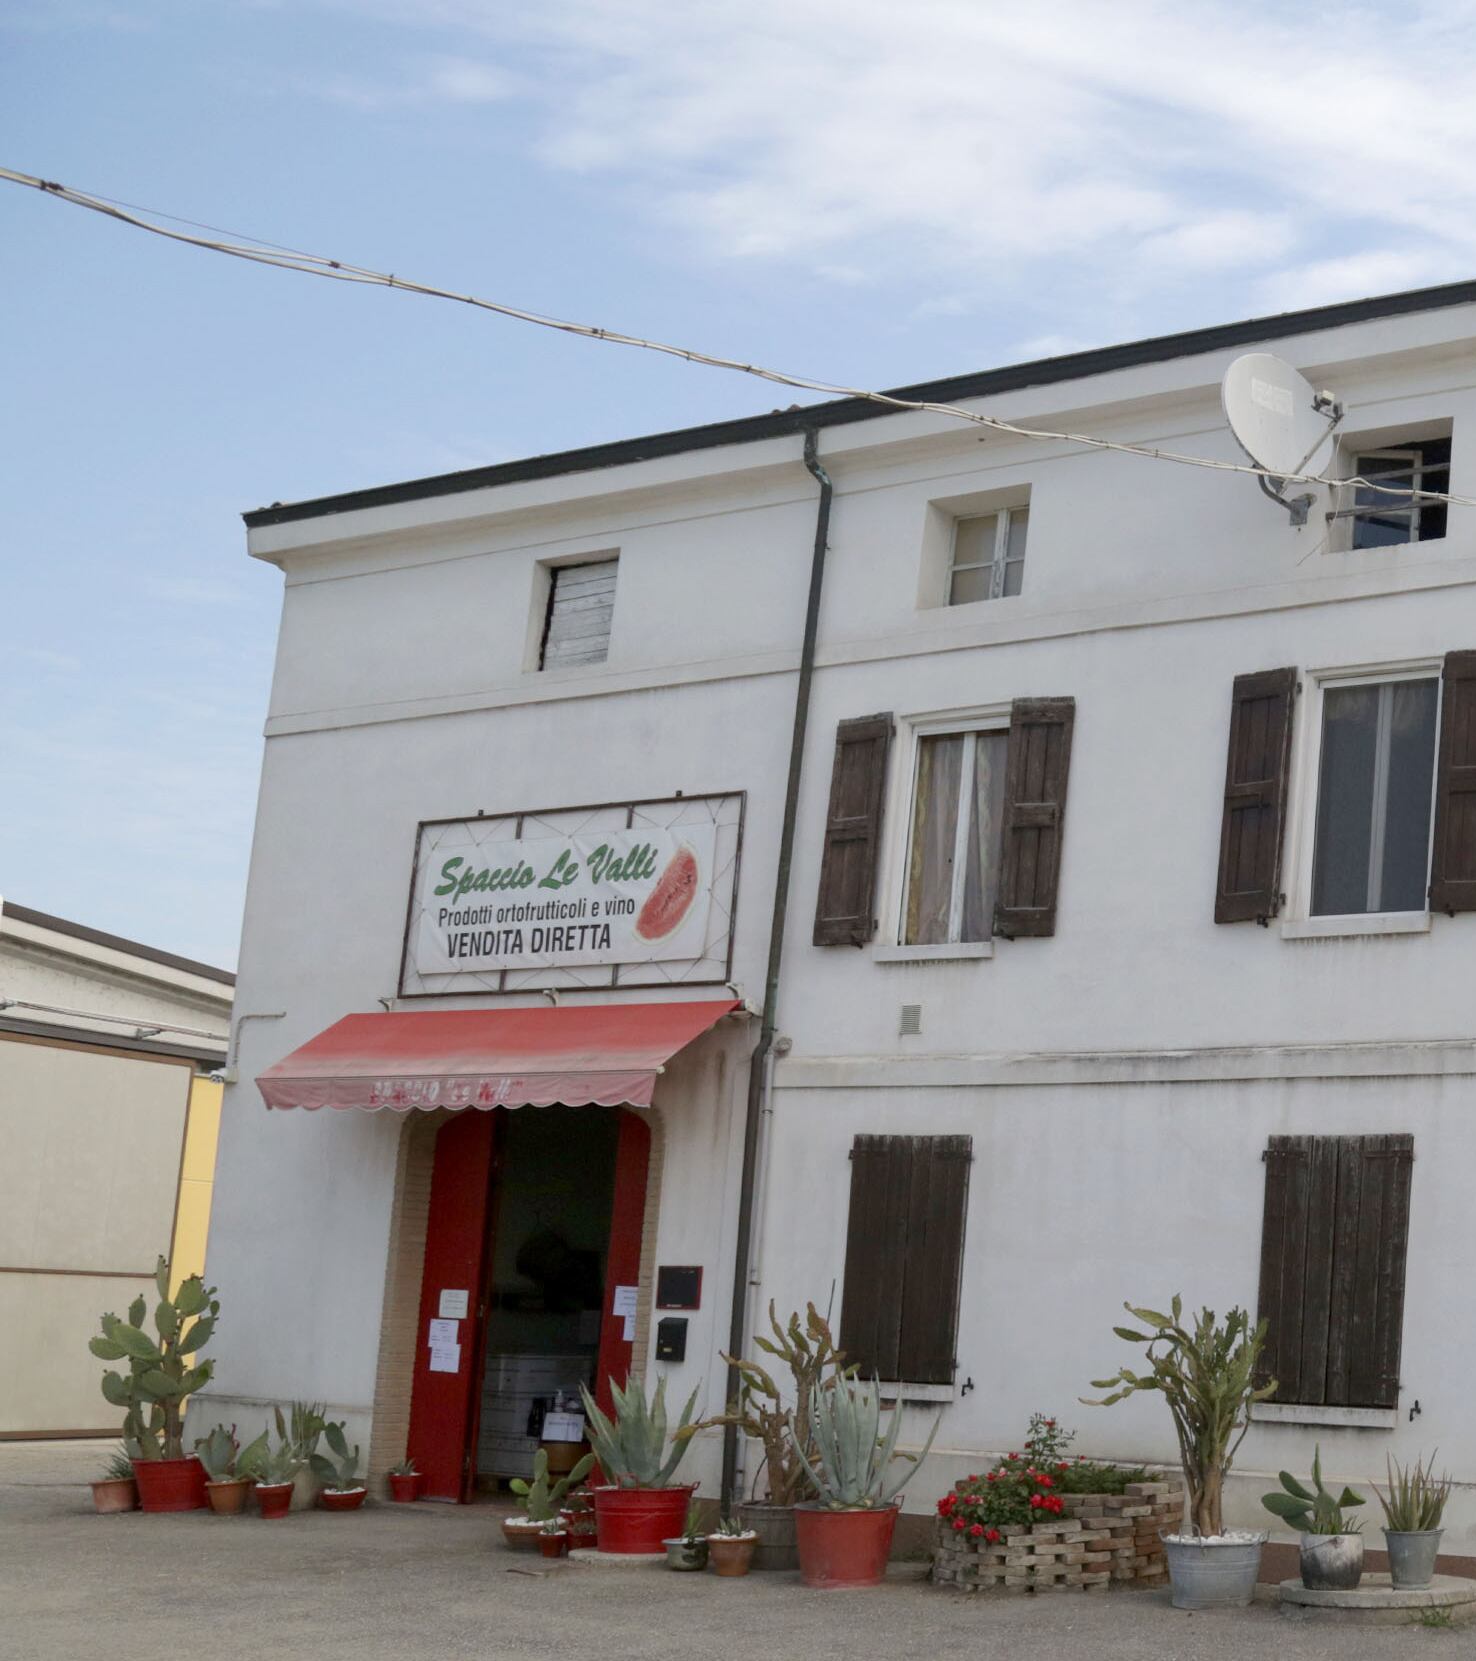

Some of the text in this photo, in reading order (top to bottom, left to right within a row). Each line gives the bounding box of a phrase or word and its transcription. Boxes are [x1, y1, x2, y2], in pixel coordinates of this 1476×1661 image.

[434, 842, 659, 905] Spaccio Le Valli
[438, 896, 635, 928] Prodotti ortofrutticoli e vino
[448, 923, 612, 958] VENDITA DIRETTA
